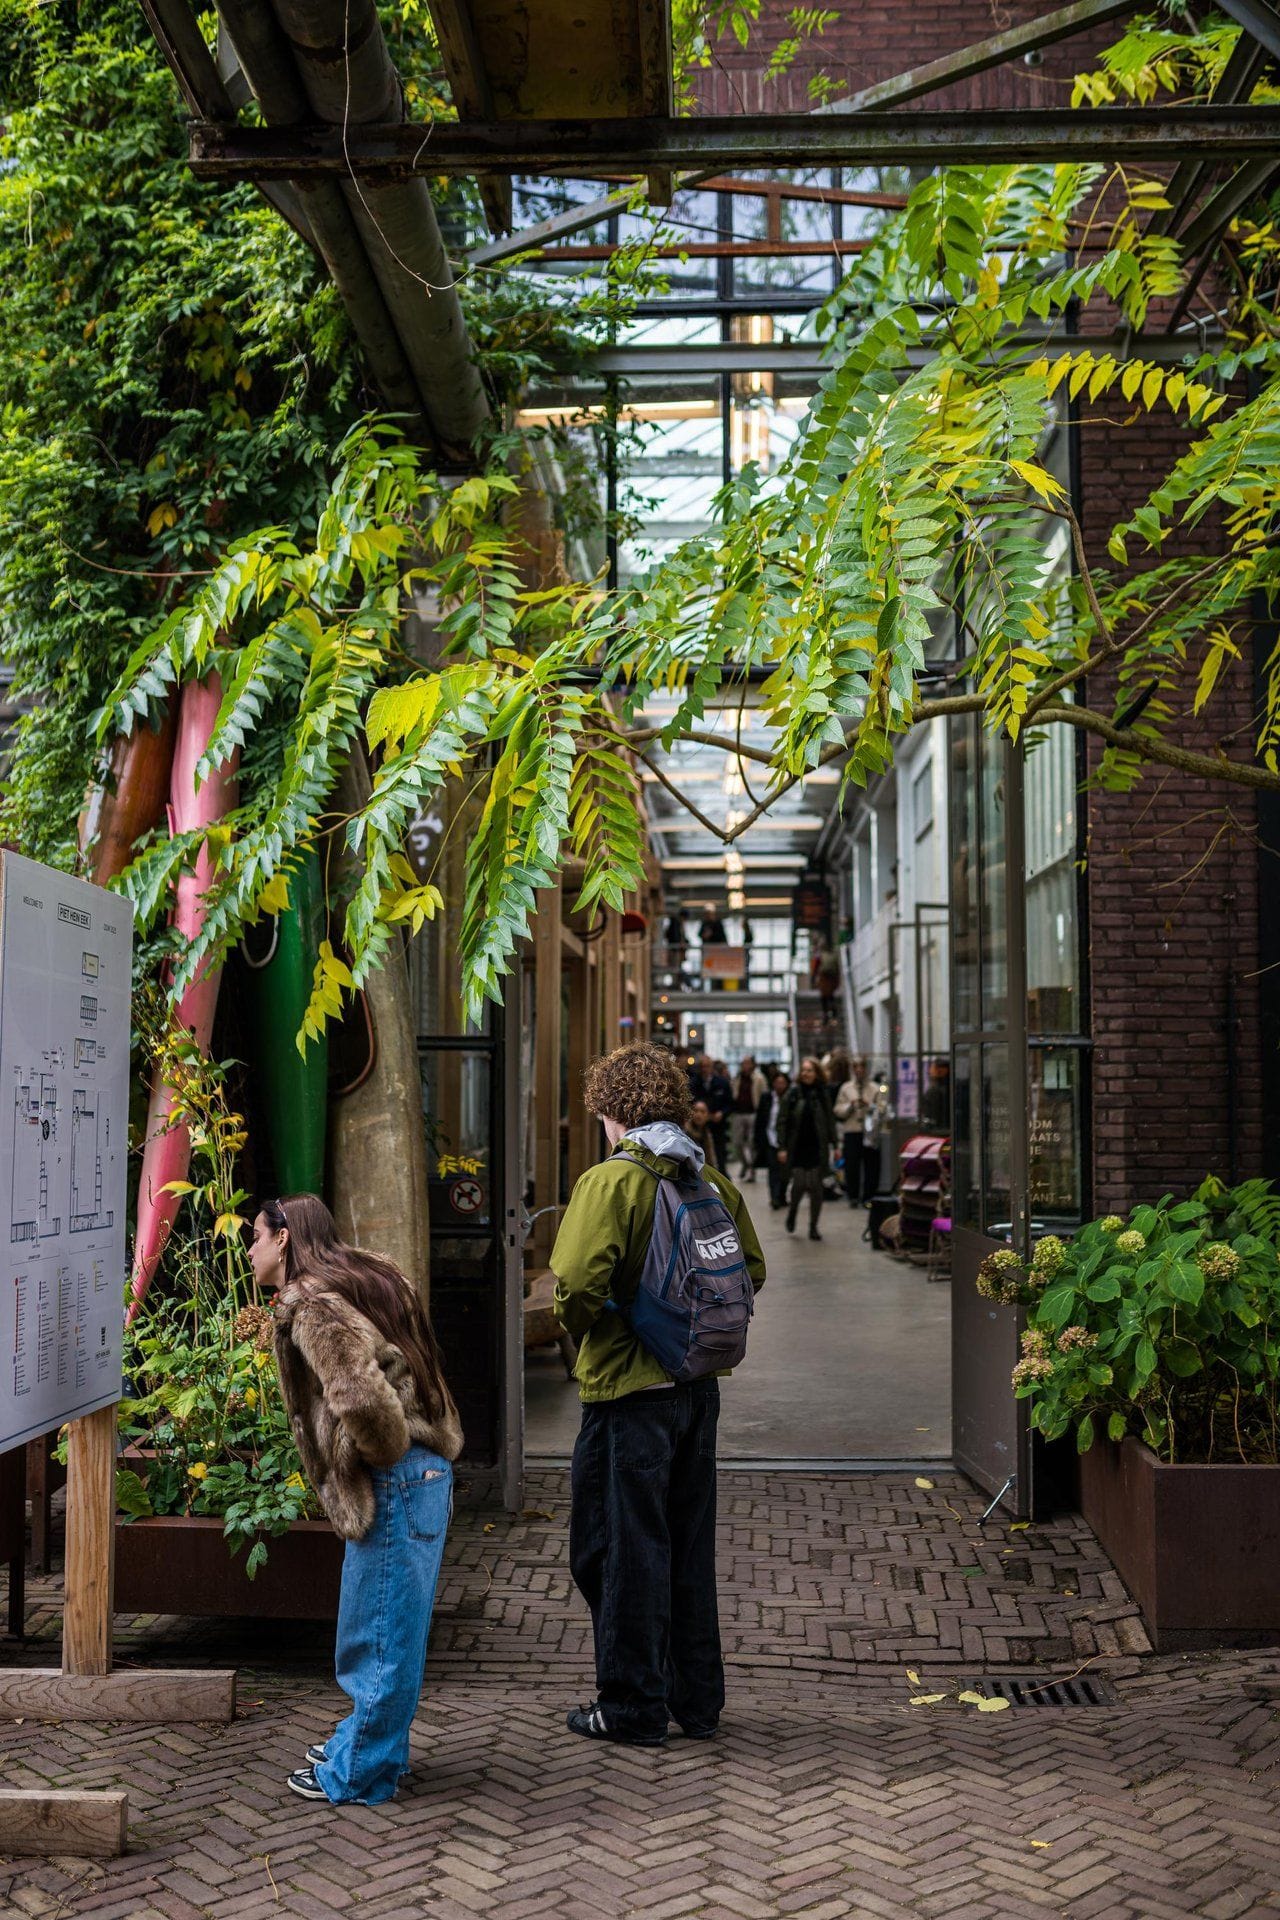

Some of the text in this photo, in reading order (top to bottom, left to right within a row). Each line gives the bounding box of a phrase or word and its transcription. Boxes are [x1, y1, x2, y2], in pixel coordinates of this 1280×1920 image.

[59, 907, 89, 926] PIET HEIN EEK
[695, 1229, 739, 1260] VANS
